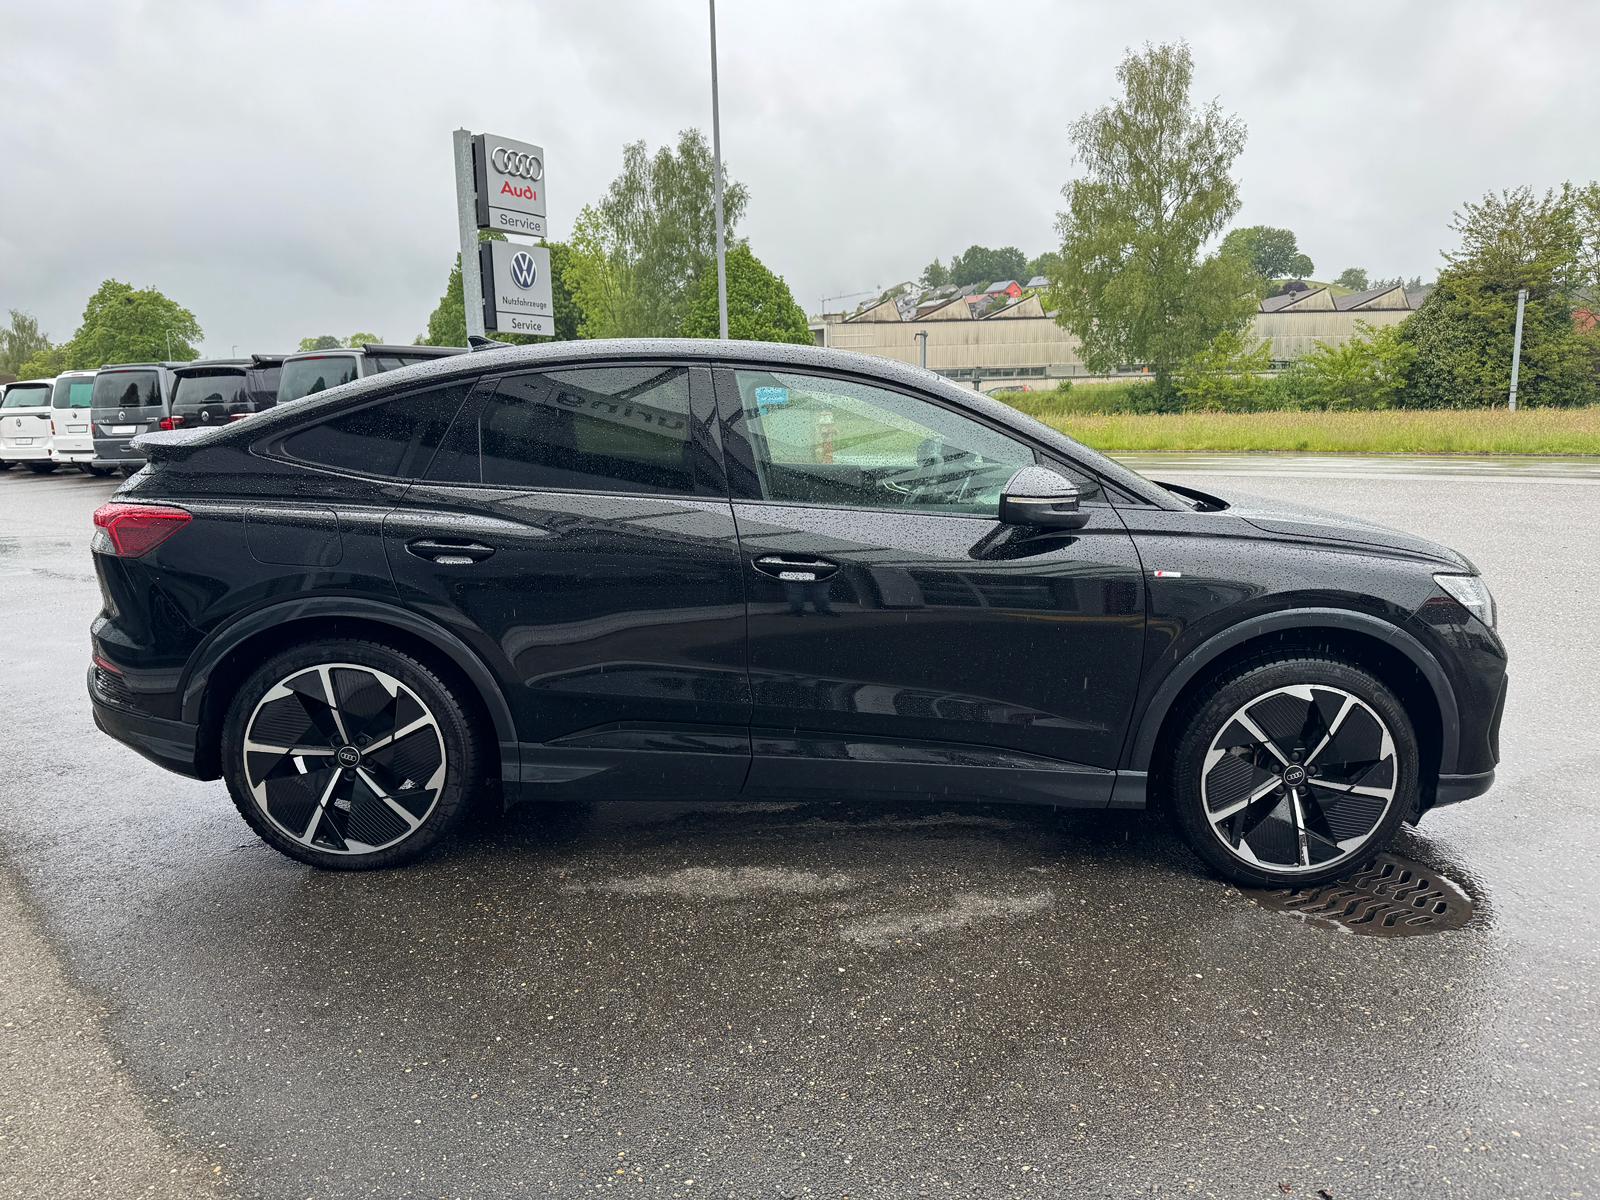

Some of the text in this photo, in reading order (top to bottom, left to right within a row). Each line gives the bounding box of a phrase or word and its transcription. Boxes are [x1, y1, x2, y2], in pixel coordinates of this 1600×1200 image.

[500, 181, 537, 201] Audi
[500, 213, 541, 231] Service
[502, 296, 547, 310] Nutzfahrzeuge
[511, 317, 542, 331] Service
